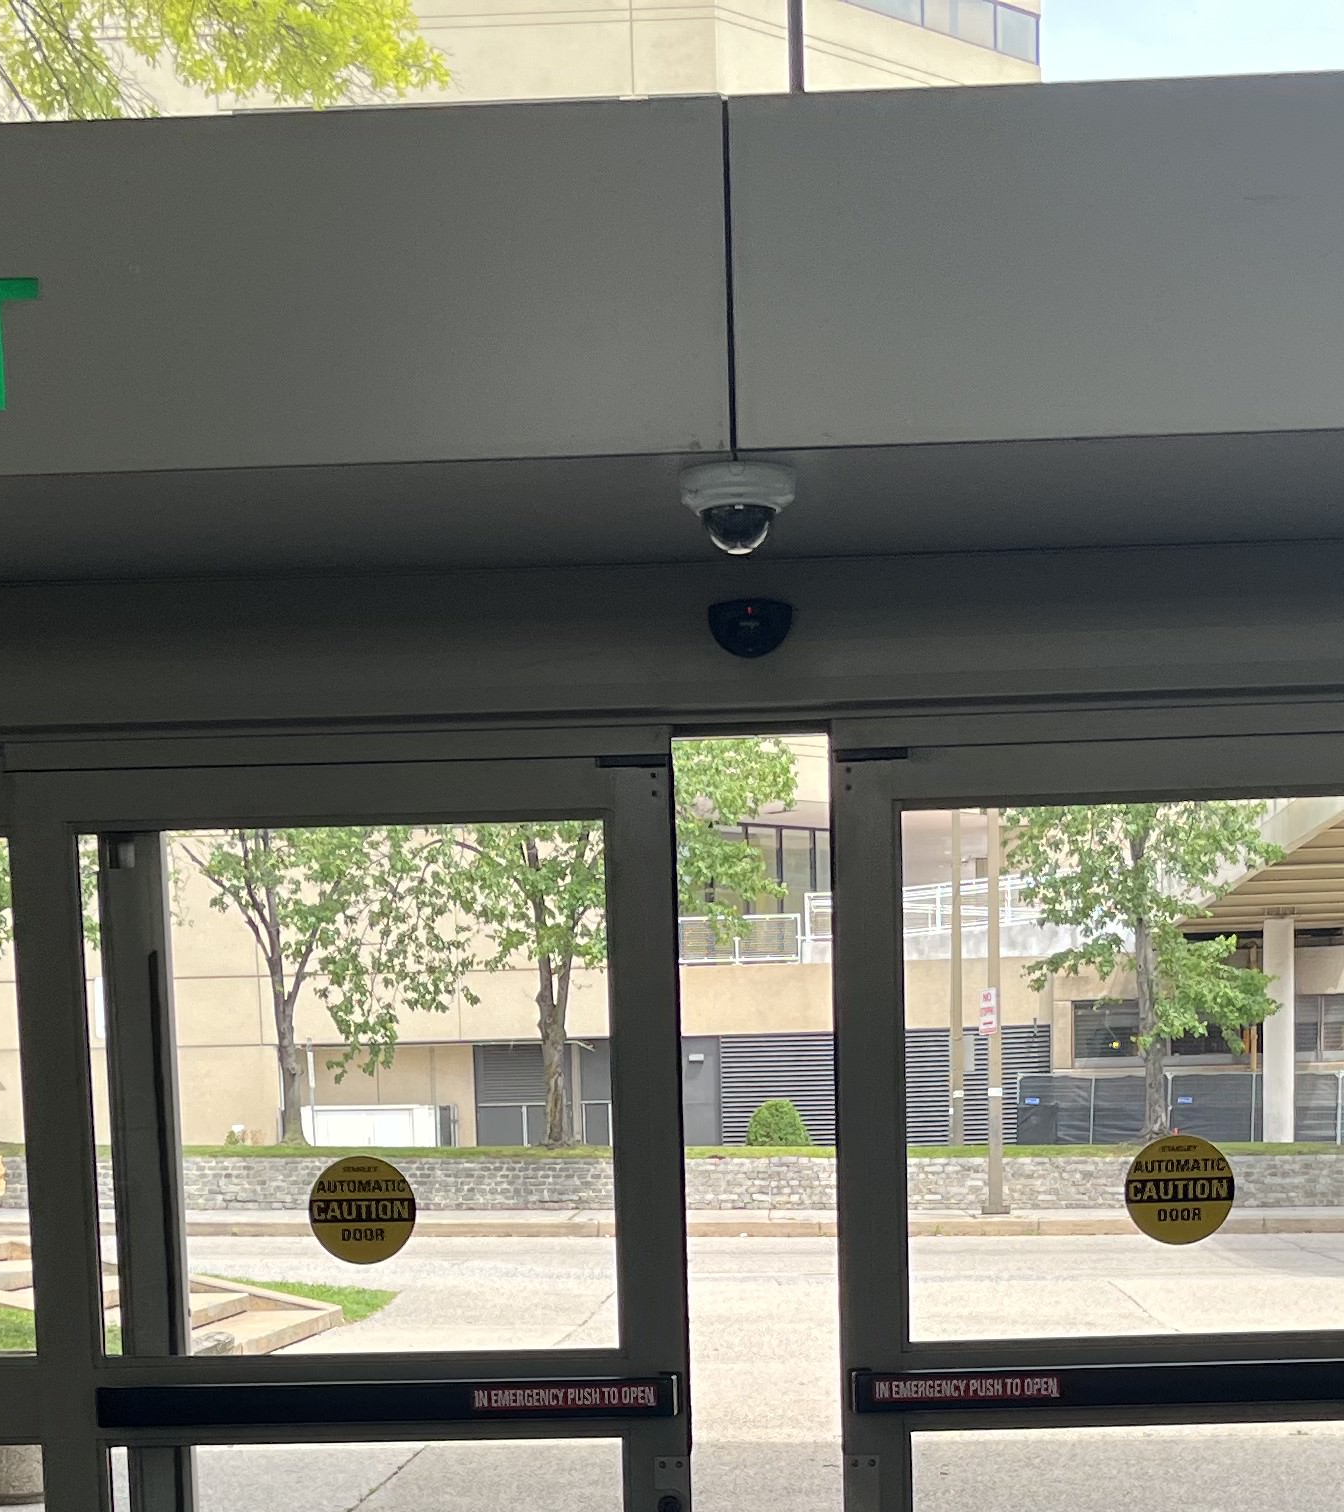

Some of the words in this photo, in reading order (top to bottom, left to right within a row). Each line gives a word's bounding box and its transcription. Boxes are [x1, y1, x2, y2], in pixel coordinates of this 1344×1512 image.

[1134, 1158, 1226, 1173] AUTOMATIC
[316, 1179, 406, 1194] AUTOMATIC
[1128, 1179, 1229, 1200] CAUTION
[312, 1200, 409, 1220] CAUTION
[1157, 1208, 1202, 1222] DOOR
[341, 1228, 385, 1242] DOOR
[875, 1381, 889, 1399] IN
[892, 1380, 966, 1398] EMERGENCY
[969, 1378, 1002, 1397] PUSH
[1005, 1378, 1022, 1396] TO
[1024, 1377, 1058, 1397] OPEN
[474, 1389, 488, 1408] IN
[491, 1388, 564, 1407] EMERGENCY
[567, 1387, 600, 1406] PUSH
[602, 1387, 619, 1406] TO
[621, 1386, 655, 1406] OPEN
